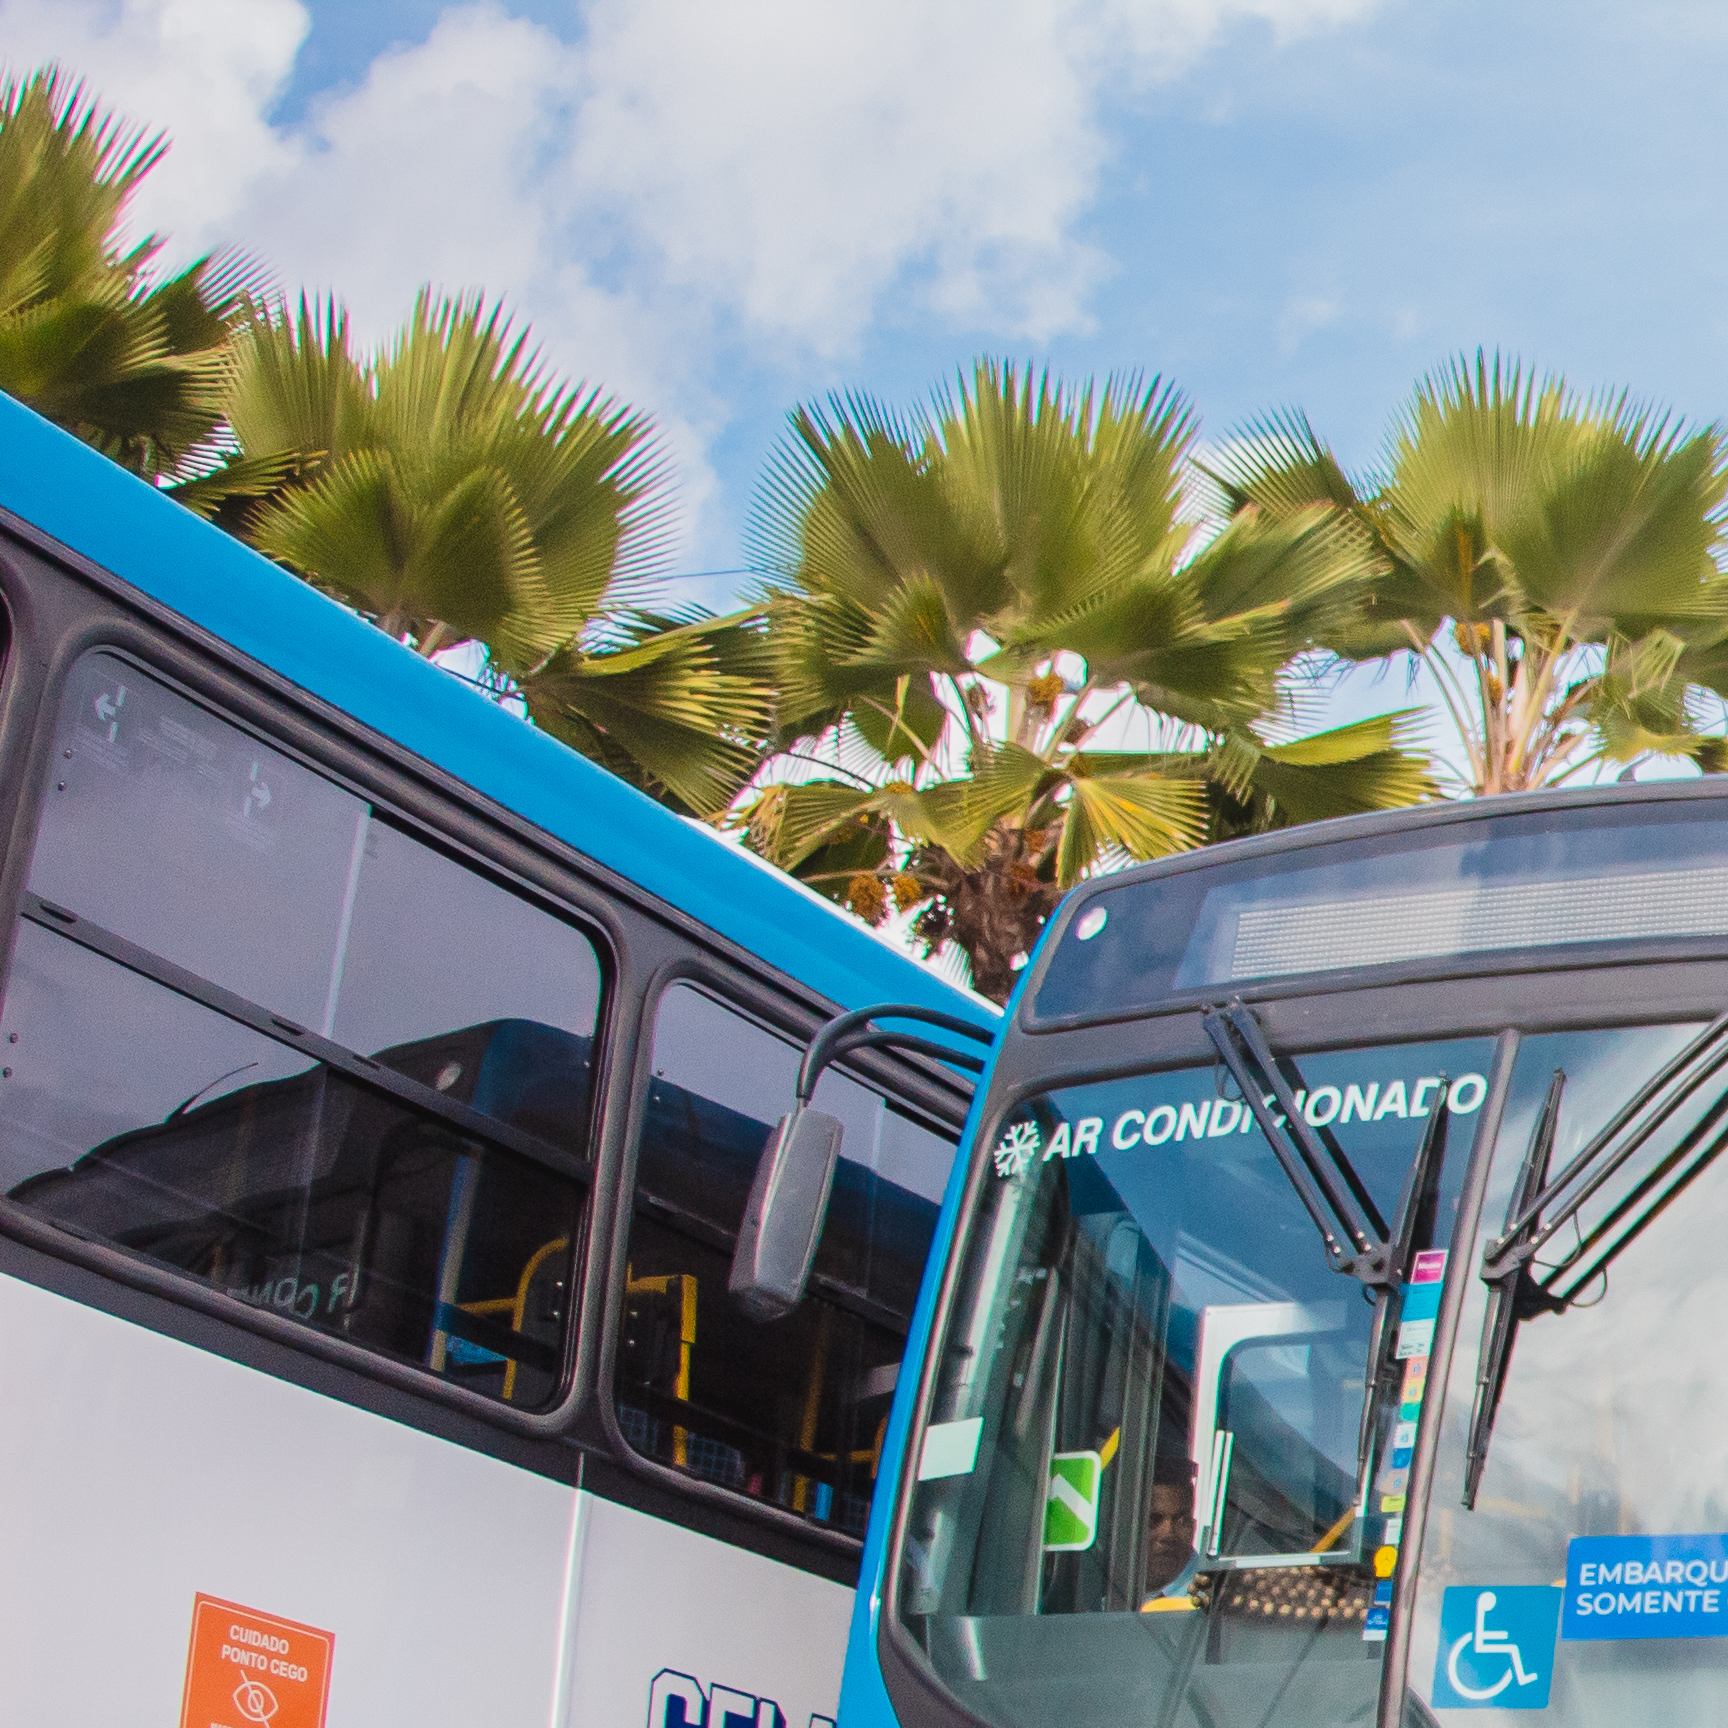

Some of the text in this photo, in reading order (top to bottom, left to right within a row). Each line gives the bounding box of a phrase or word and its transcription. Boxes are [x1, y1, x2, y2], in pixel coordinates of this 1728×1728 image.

[1043, 1117, 1103, 1162] AR
[1576, 1589, 1721, 1616] SOMENTE
[229, 1624, 290, 1655] CUIDADO
[221, 1644, 309, 1683] PONTO CEGO
